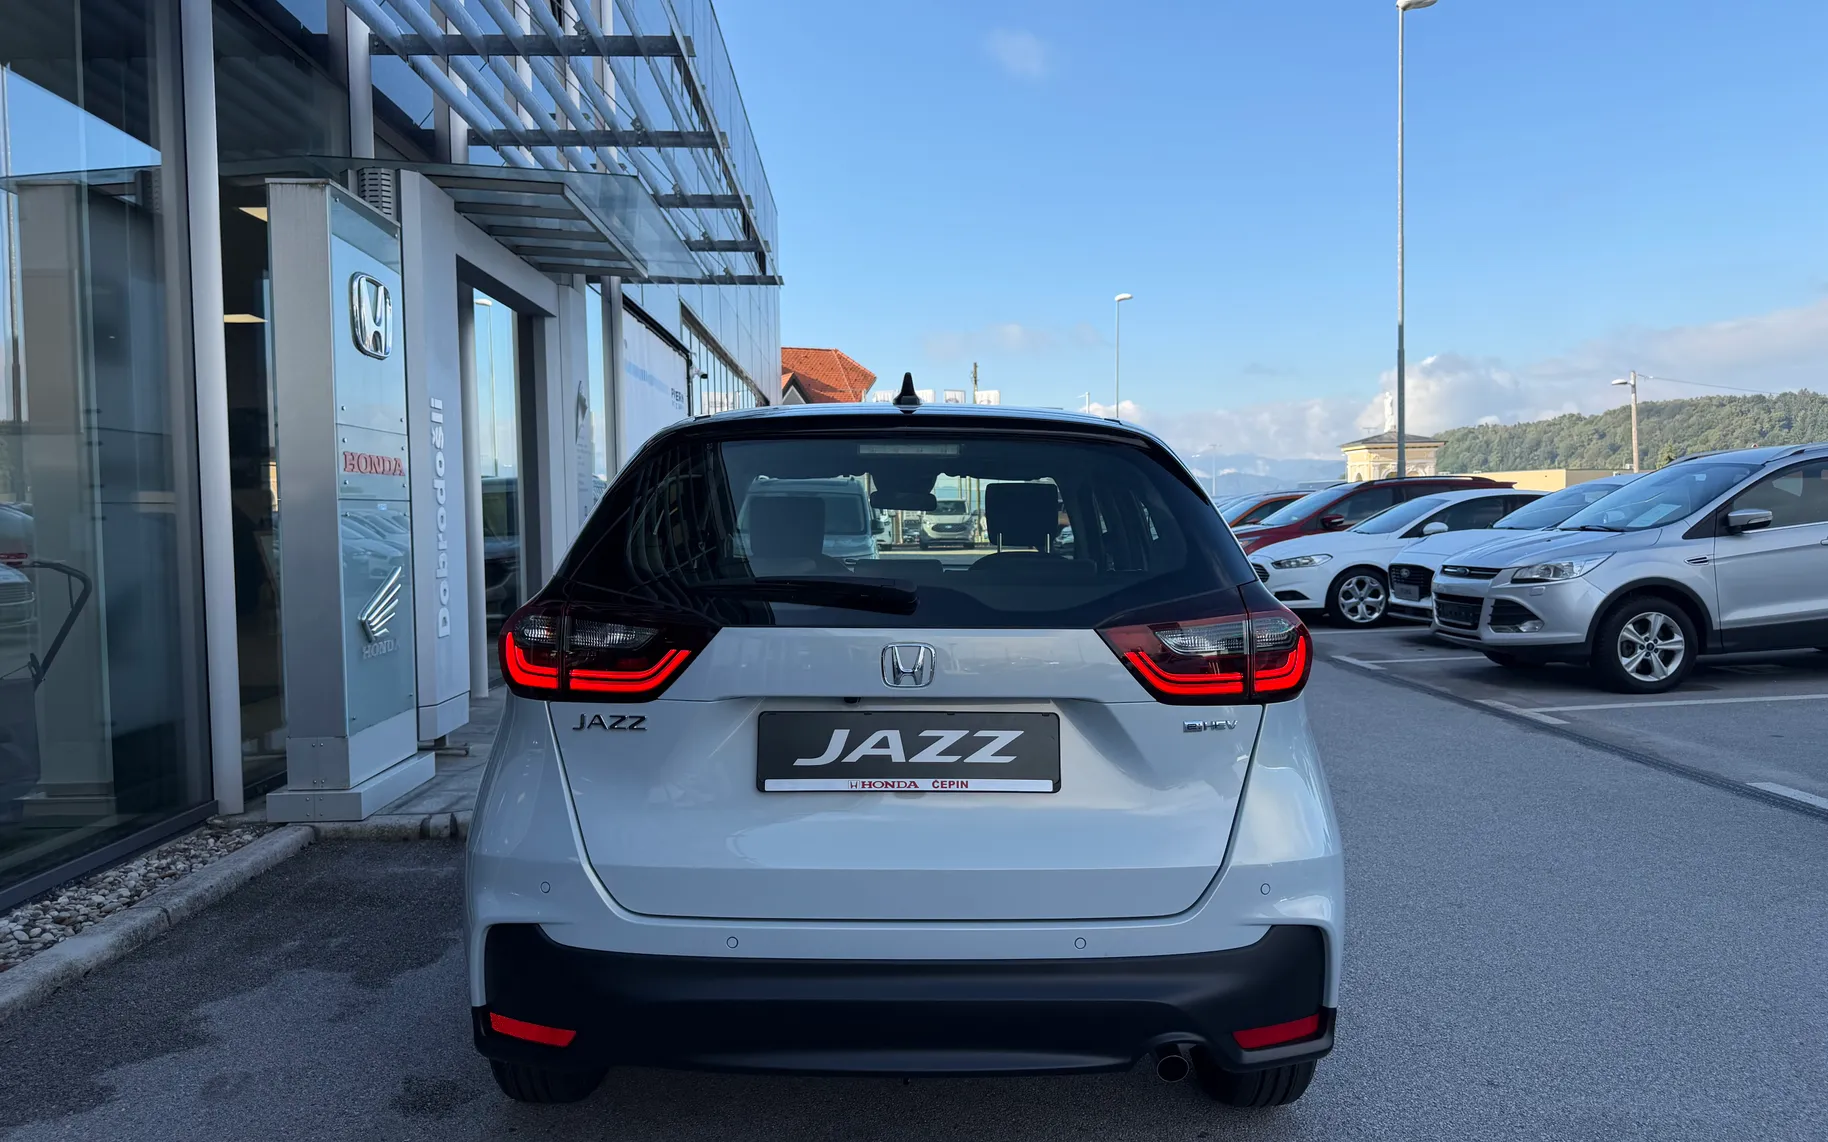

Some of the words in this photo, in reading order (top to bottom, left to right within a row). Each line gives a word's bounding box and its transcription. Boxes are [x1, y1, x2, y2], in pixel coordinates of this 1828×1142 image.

[343, 451, 405, 476] HONDA
[430, 398, 450, 638] Dobrodošli
[572, 713, 647, 731] JAZZ
[793, 729, 1024, 766] JAZZ
[861, 780, 919, 789] HONDA
[932, 779, 969, 789] ČEPIN
